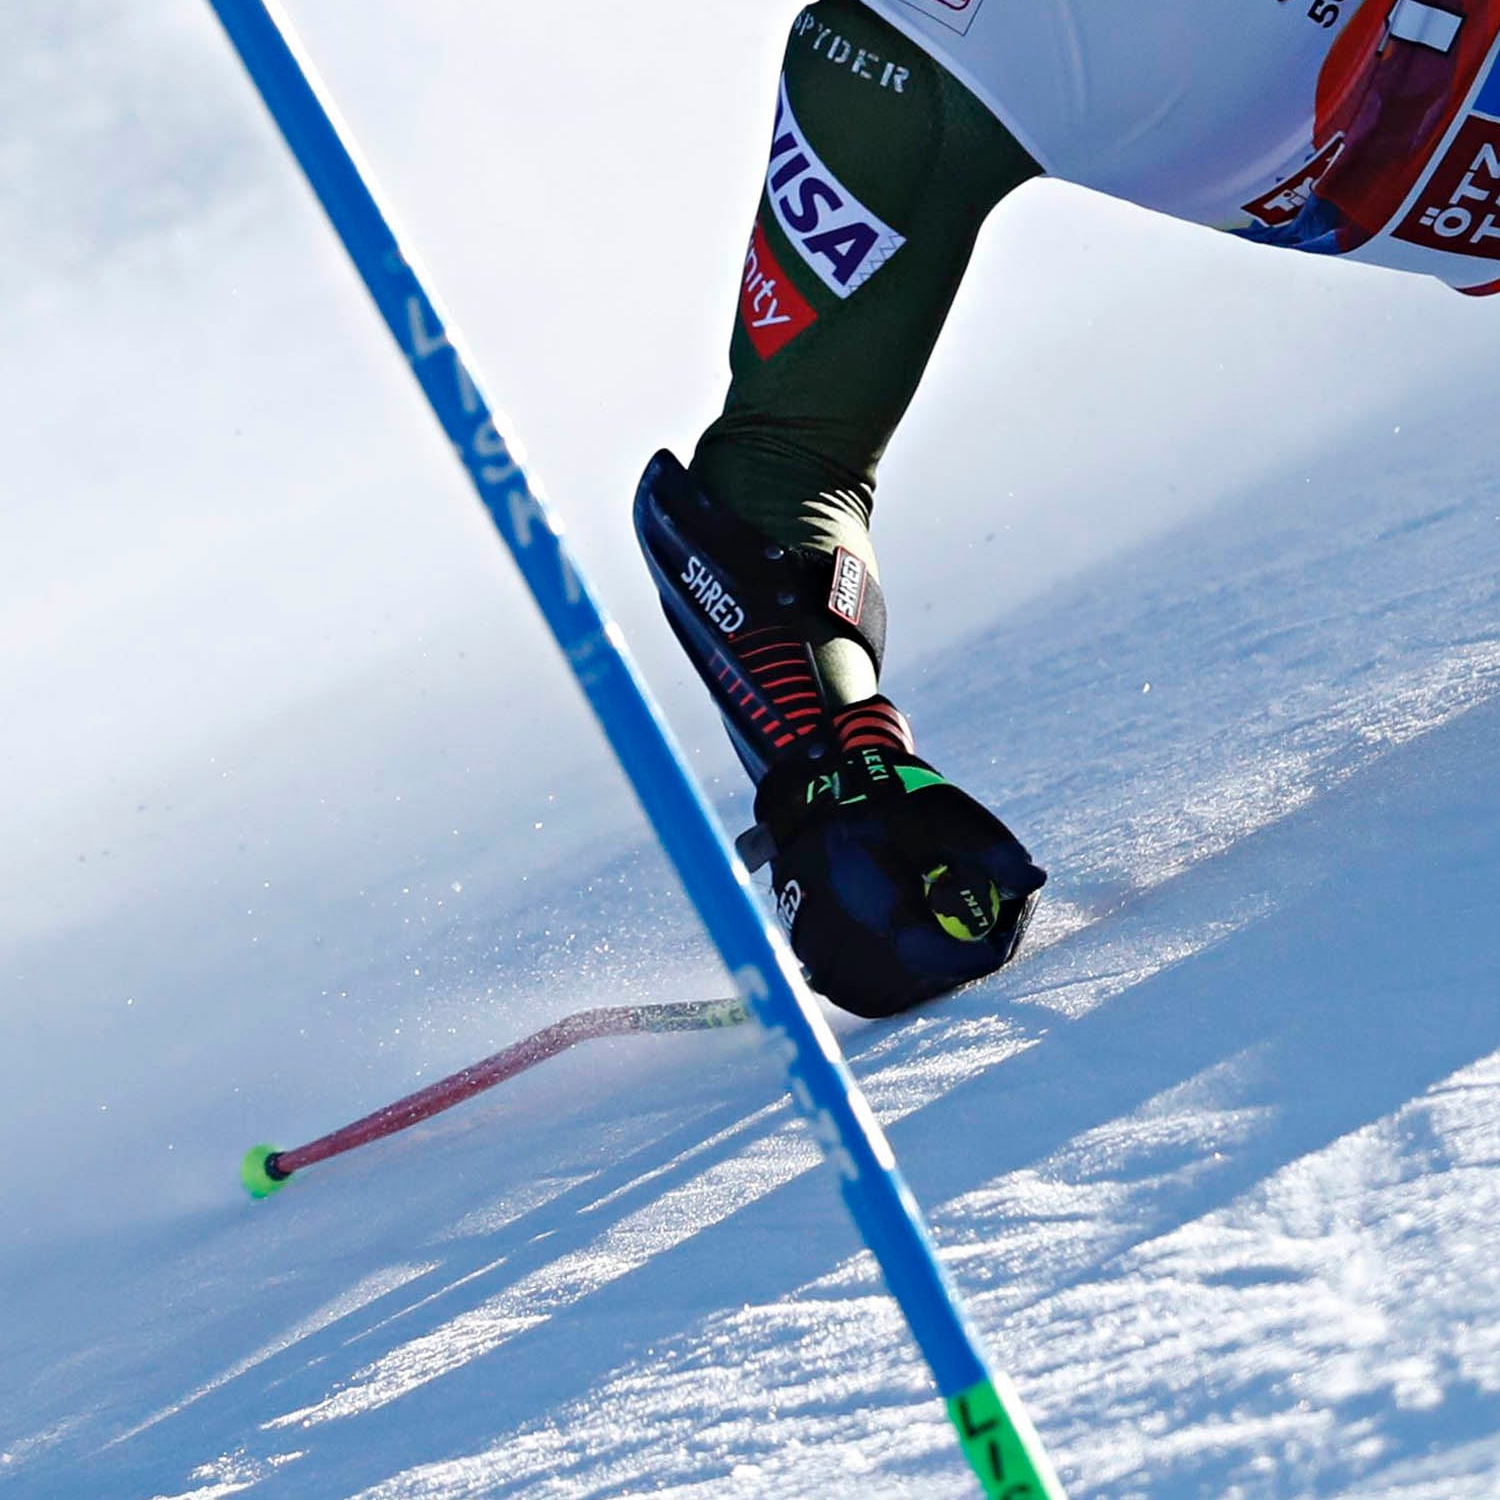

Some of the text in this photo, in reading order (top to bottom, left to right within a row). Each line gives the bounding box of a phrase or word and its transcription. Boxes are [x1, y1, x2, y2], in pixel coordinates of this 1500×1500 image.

[680, 555, 744, 633] SHRED
[836, 555, 861, 618] SHRED
[861, 748, 890, 781] LEKI
[960, 889, 989, 928] LEKI
